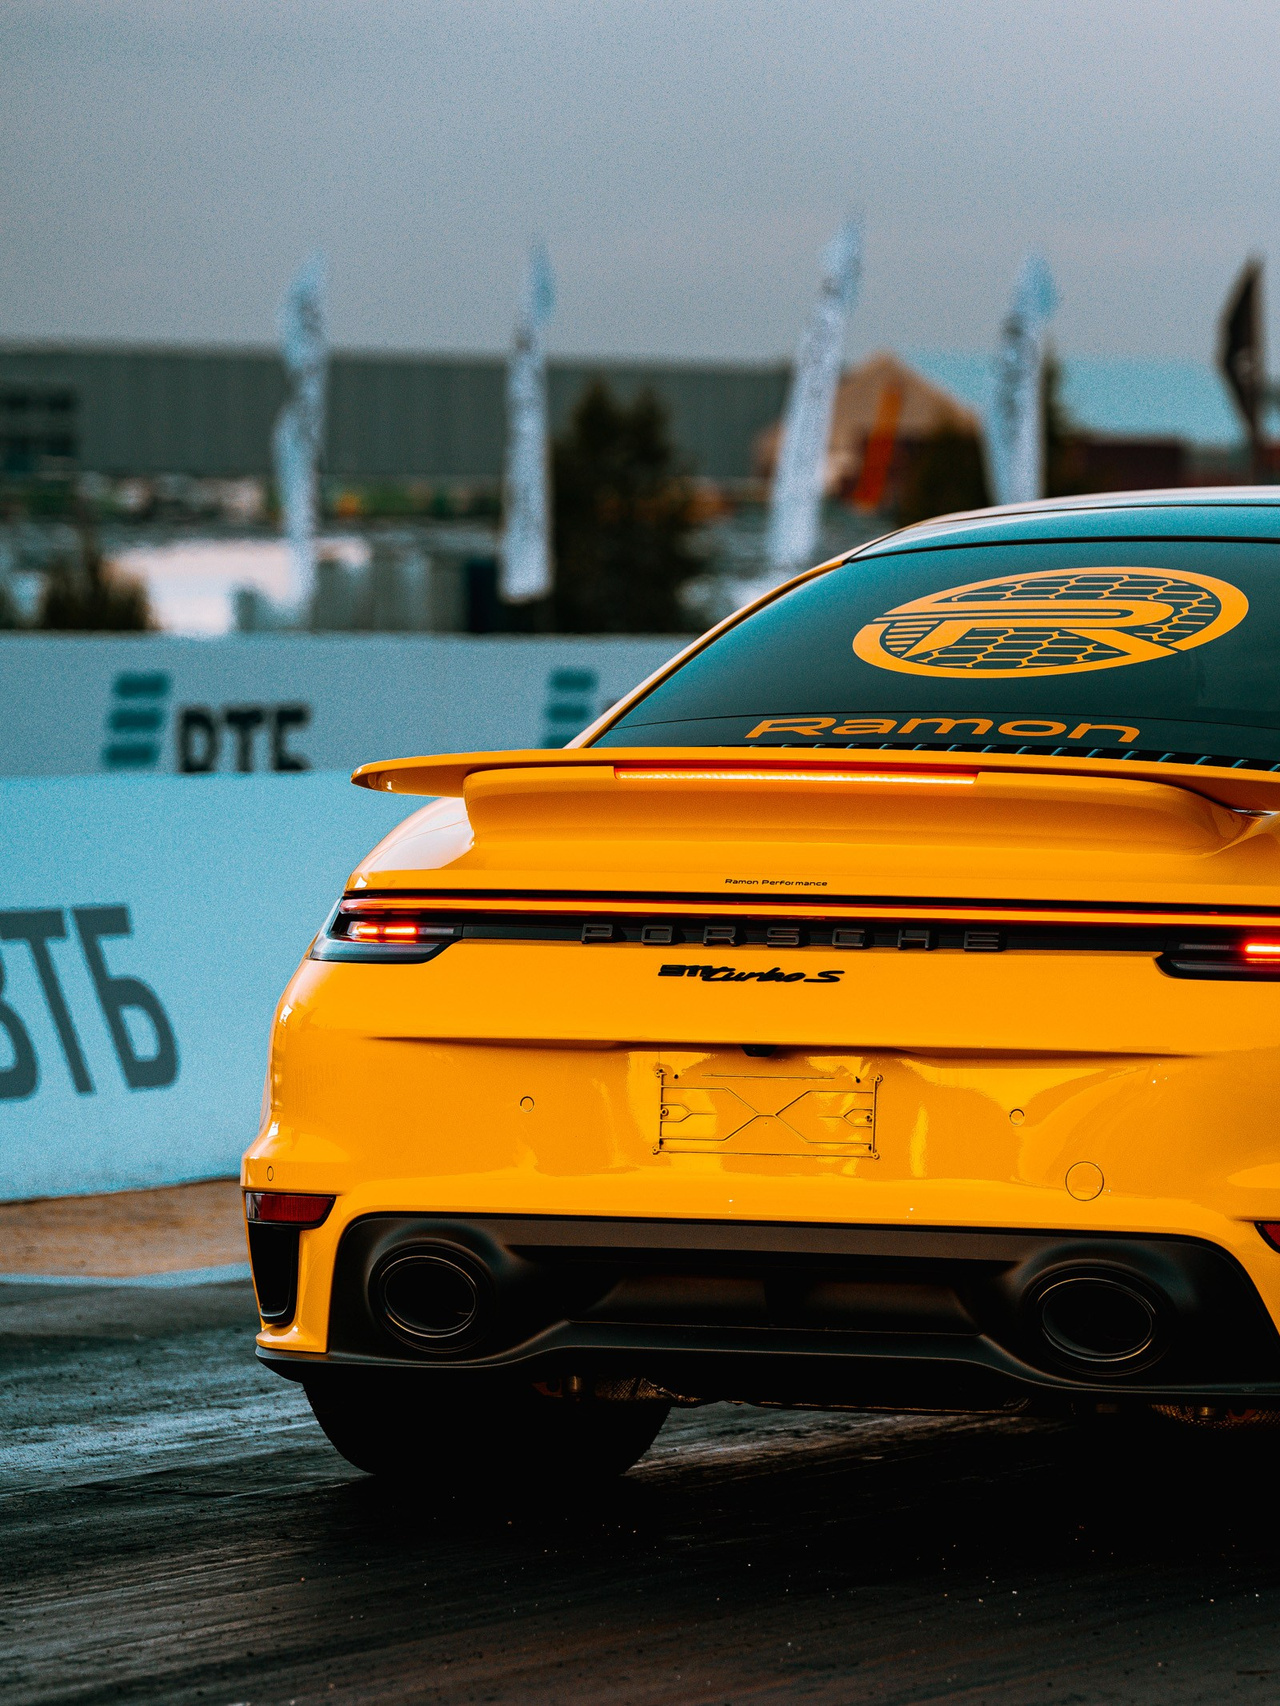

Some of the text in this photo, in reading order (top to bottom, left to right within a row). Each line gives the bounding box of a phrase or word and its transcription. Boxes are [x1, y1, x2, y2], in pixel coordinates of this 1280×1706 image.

[744, 717, 1140, 744] Ramon
[725, 878, 828, 887] Ramon Performance
[581, 923, 1001, 951] PORSCHE
[702, 966, 806, 982] turbo
[803, 970, 846, 983] S
